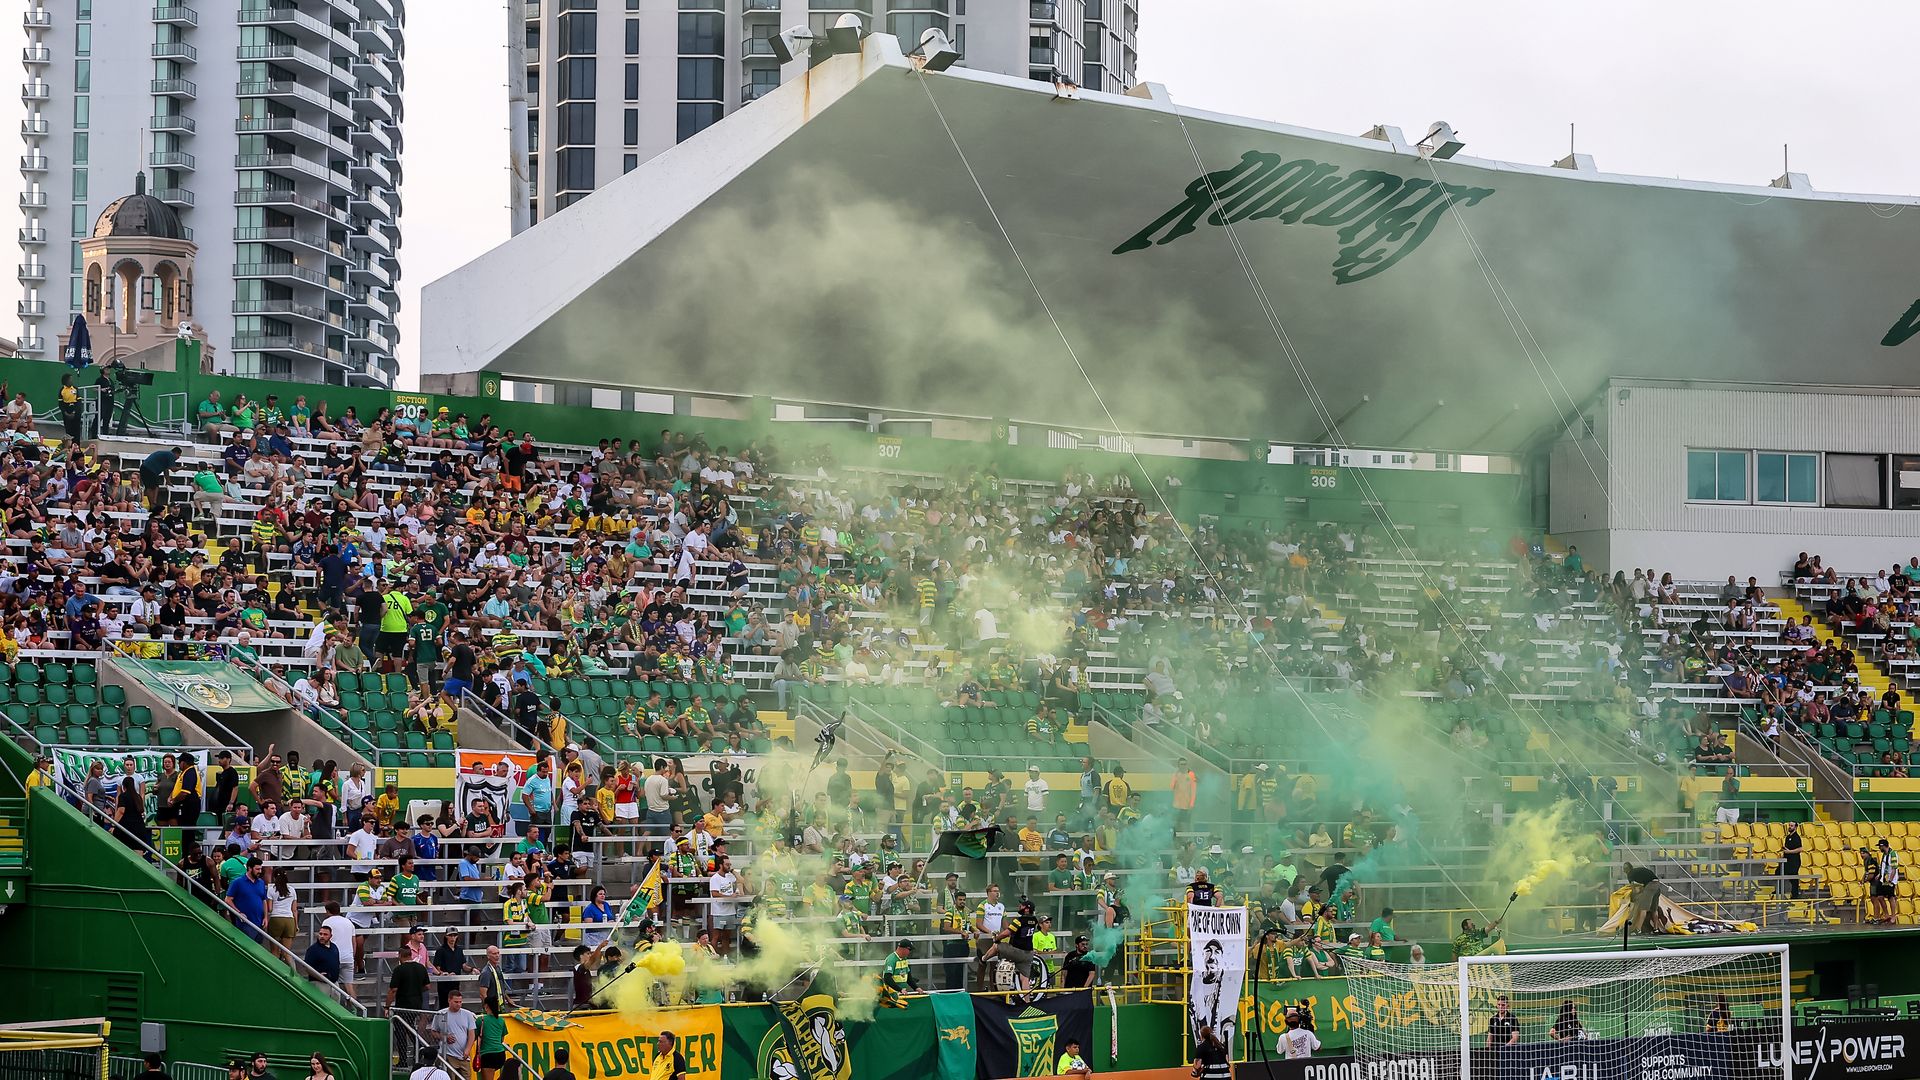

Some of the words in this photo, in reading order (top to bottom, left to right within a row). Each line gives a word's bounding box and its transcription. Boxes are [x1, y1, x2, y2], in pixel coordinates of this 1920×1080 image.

[396, 395, 428, 404] SECTION
[879, 445, 901, 458] 307
[1311, 476, 1336, 488] 306
[387, 601, 399, 610] 78
[420, 629, 433, 641] 23
[165, 846, 179, 856] 113
[1199, 891, 1209, 900] 15
[1211, 913, 1226, 935] OUR
[1226, 913, 1241, 934] OWN
[1331, 995, 1367, 1032] AS
[1374, 991, 1420, 1030] ONE
[1020, 1033, 1042, 1054] SC
[1831, 1035, 1906, 1063] POWER
[1641, 1054, 1686, 1068] SUPPORTS
[1662, 1066, 1713, 1079] COMMUNITY
